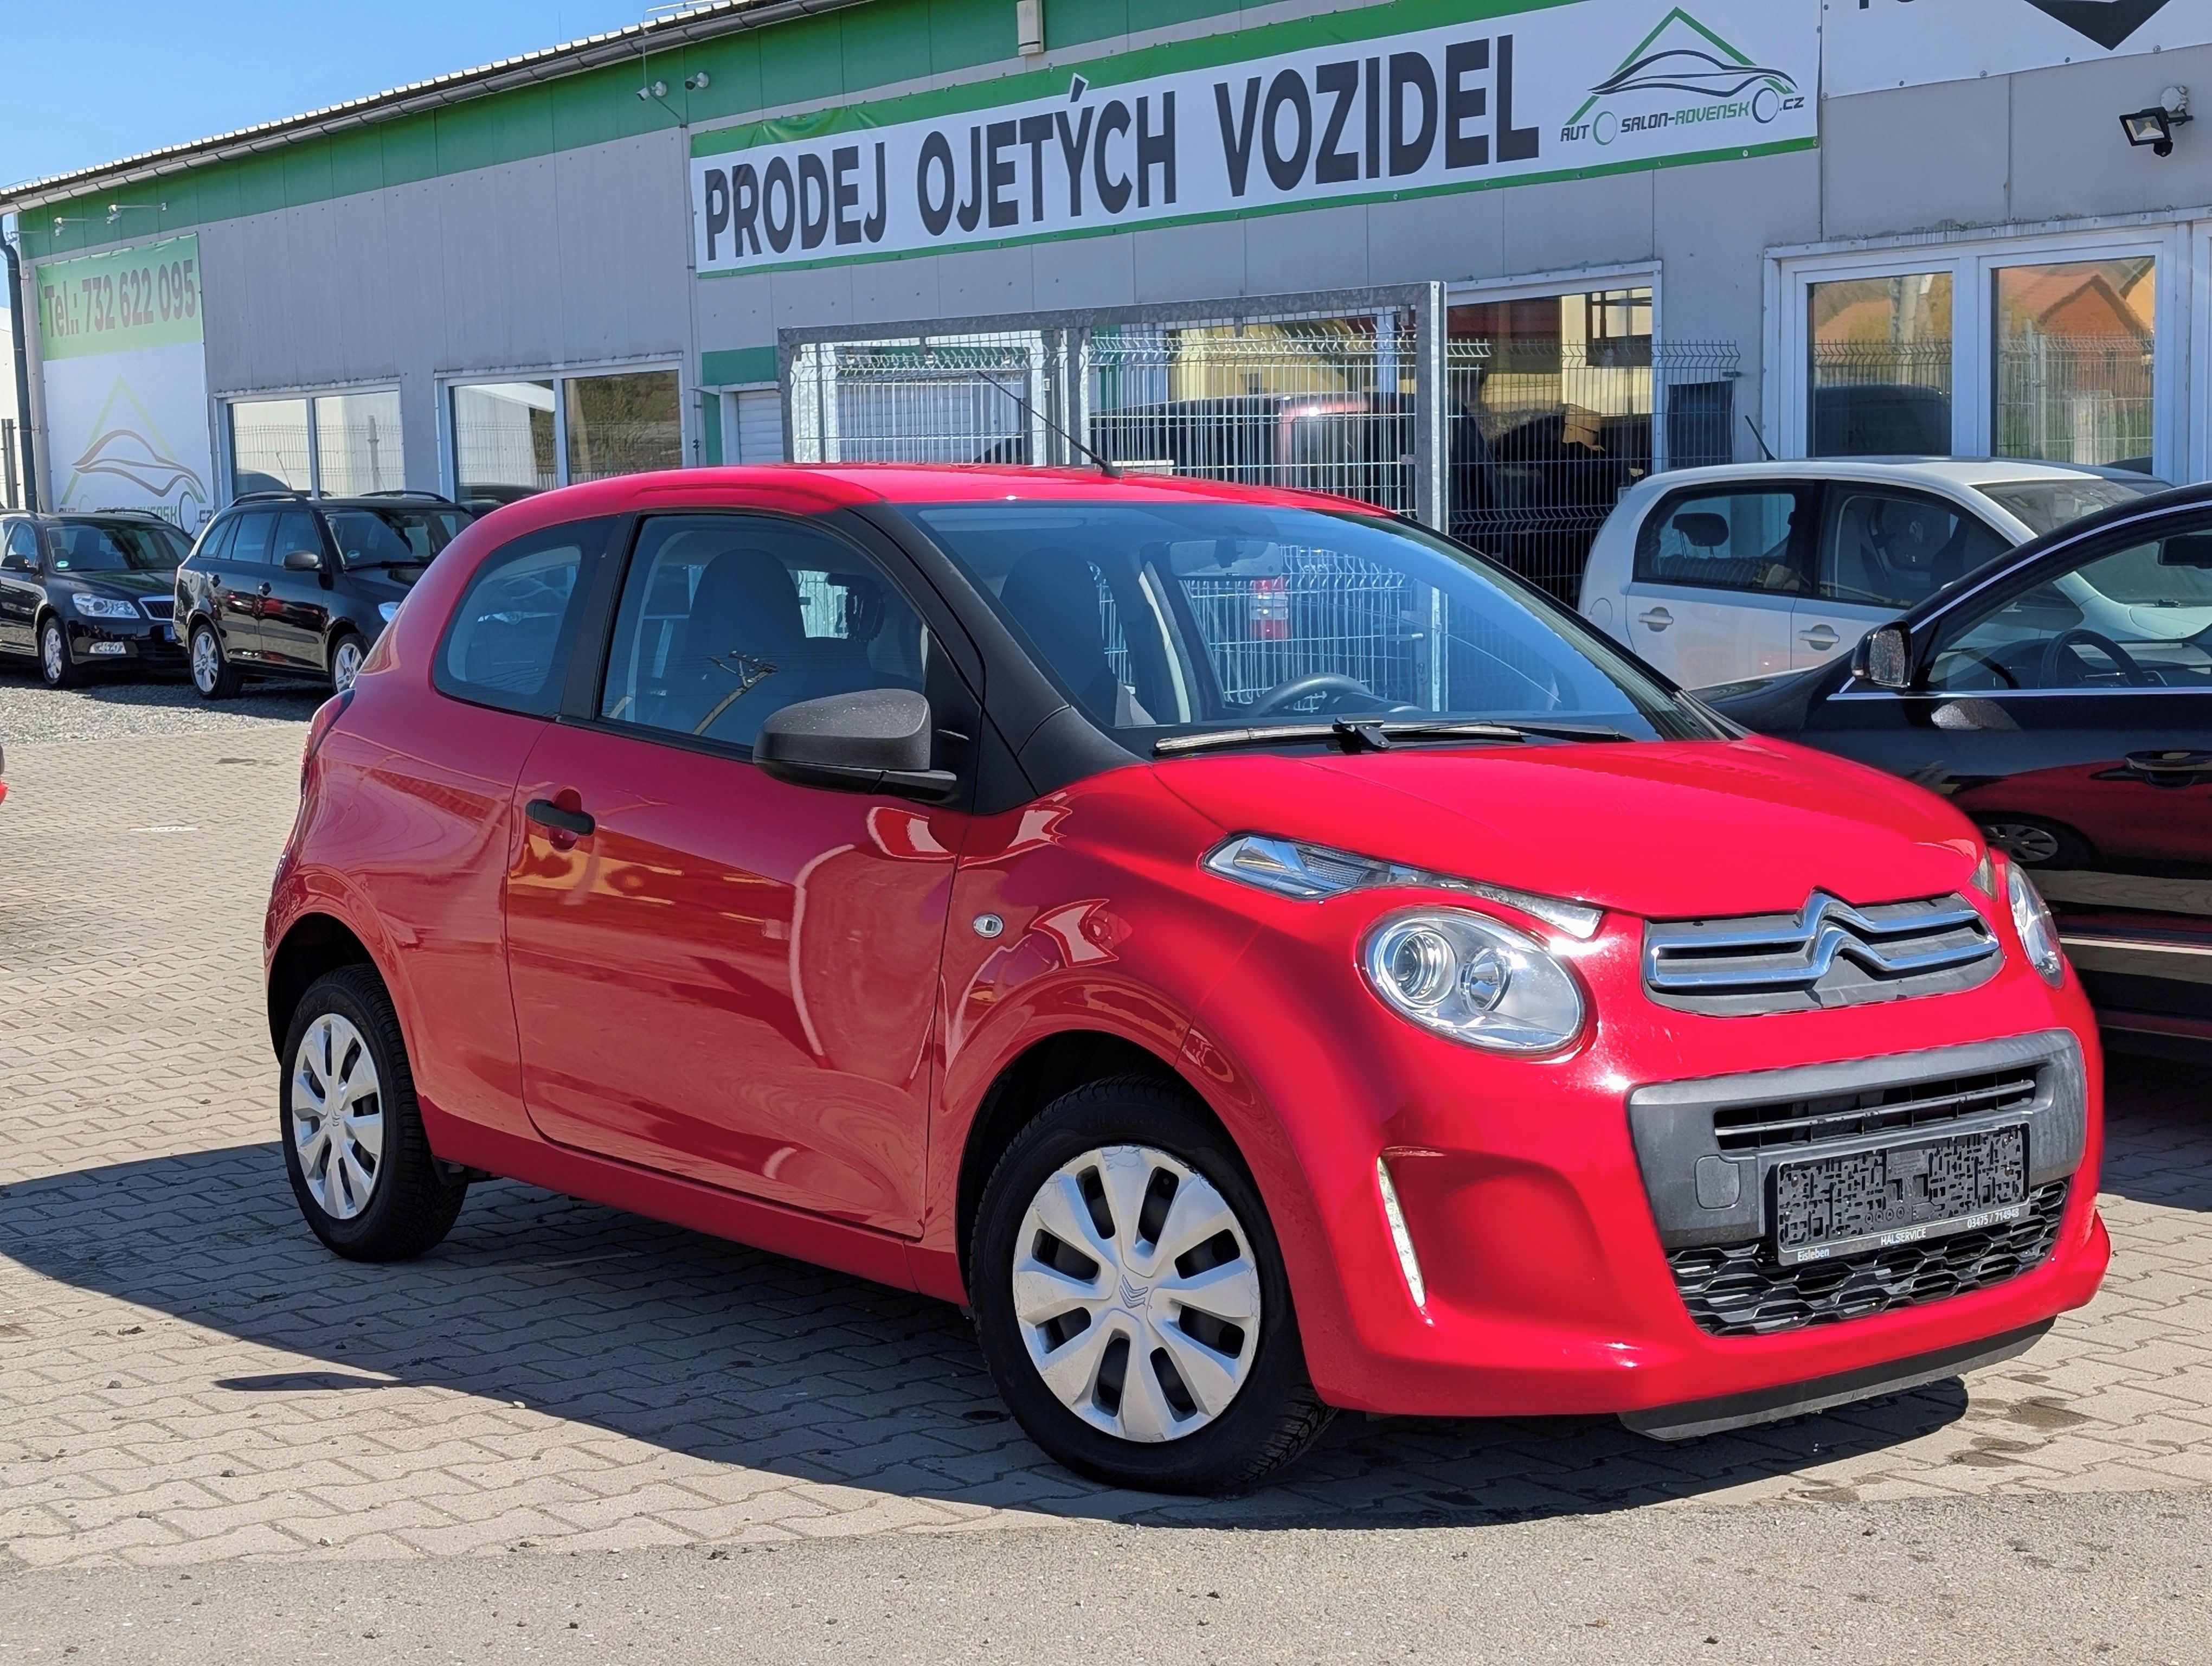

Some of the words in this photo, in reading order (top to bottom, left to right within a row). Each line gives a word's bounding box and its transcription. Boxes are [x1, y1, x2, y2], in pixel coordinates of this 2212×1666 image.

[704, 164, 886, 261] PRODEJ
[916, 74, 1177, 236] OJETÝCH
[1213, 34, 1539, 197] VOZIDEL
[44, 280, 79, 337] Tel.:
[82, 274, 115, 332] 732
[119, 268, 153, 328] 622
[158, 259, 195, 322] 095
